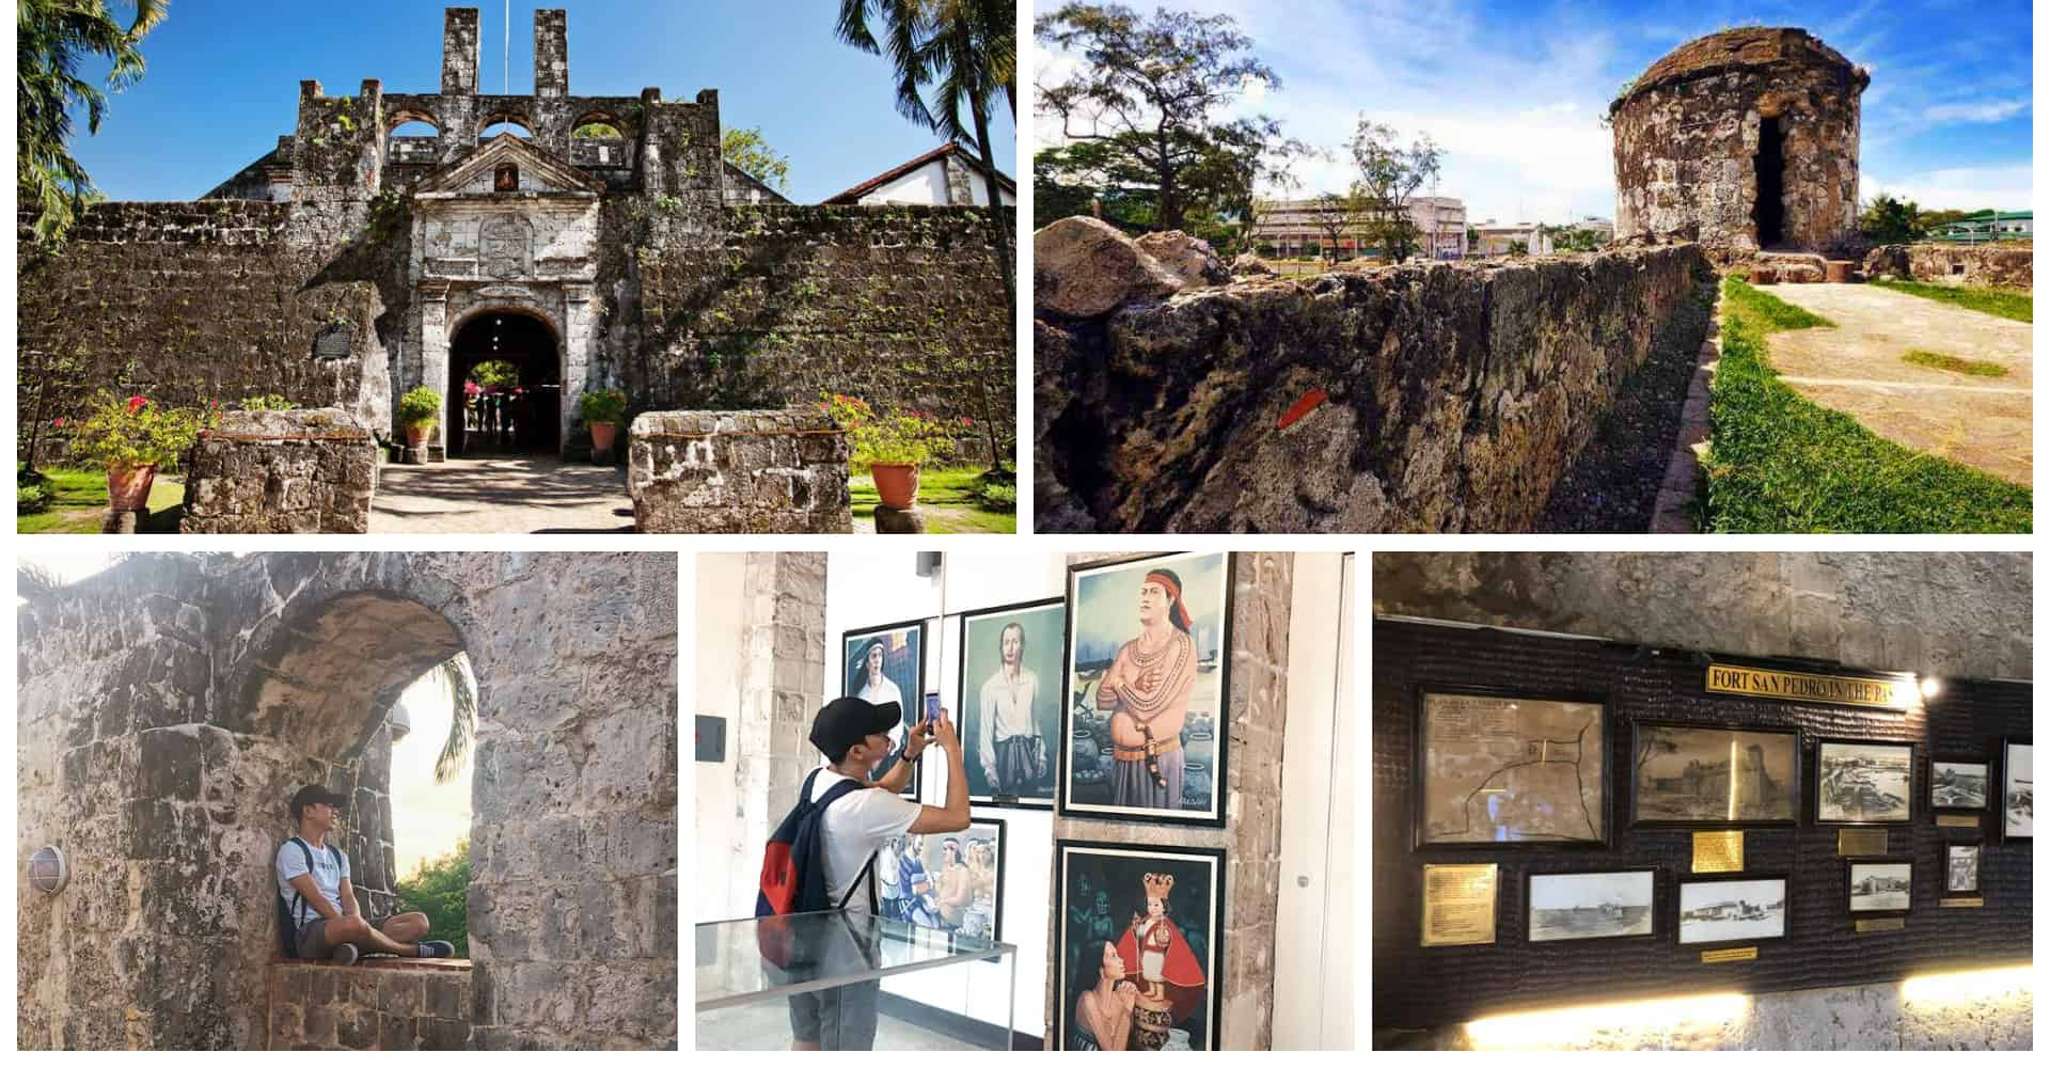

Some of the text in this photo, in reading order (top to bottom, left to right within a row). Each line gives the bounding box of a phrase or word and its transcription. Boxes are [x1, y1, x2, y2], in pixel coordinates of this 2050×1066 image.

[1713, 669, 1749, 689] FORT
[1752, 673, 1779, 692] SAN
[1782, 676, 1826, 697] PEDRO
[1829, 680, 1843, 698] IN
[1845, 682, 1872, 701] THE
